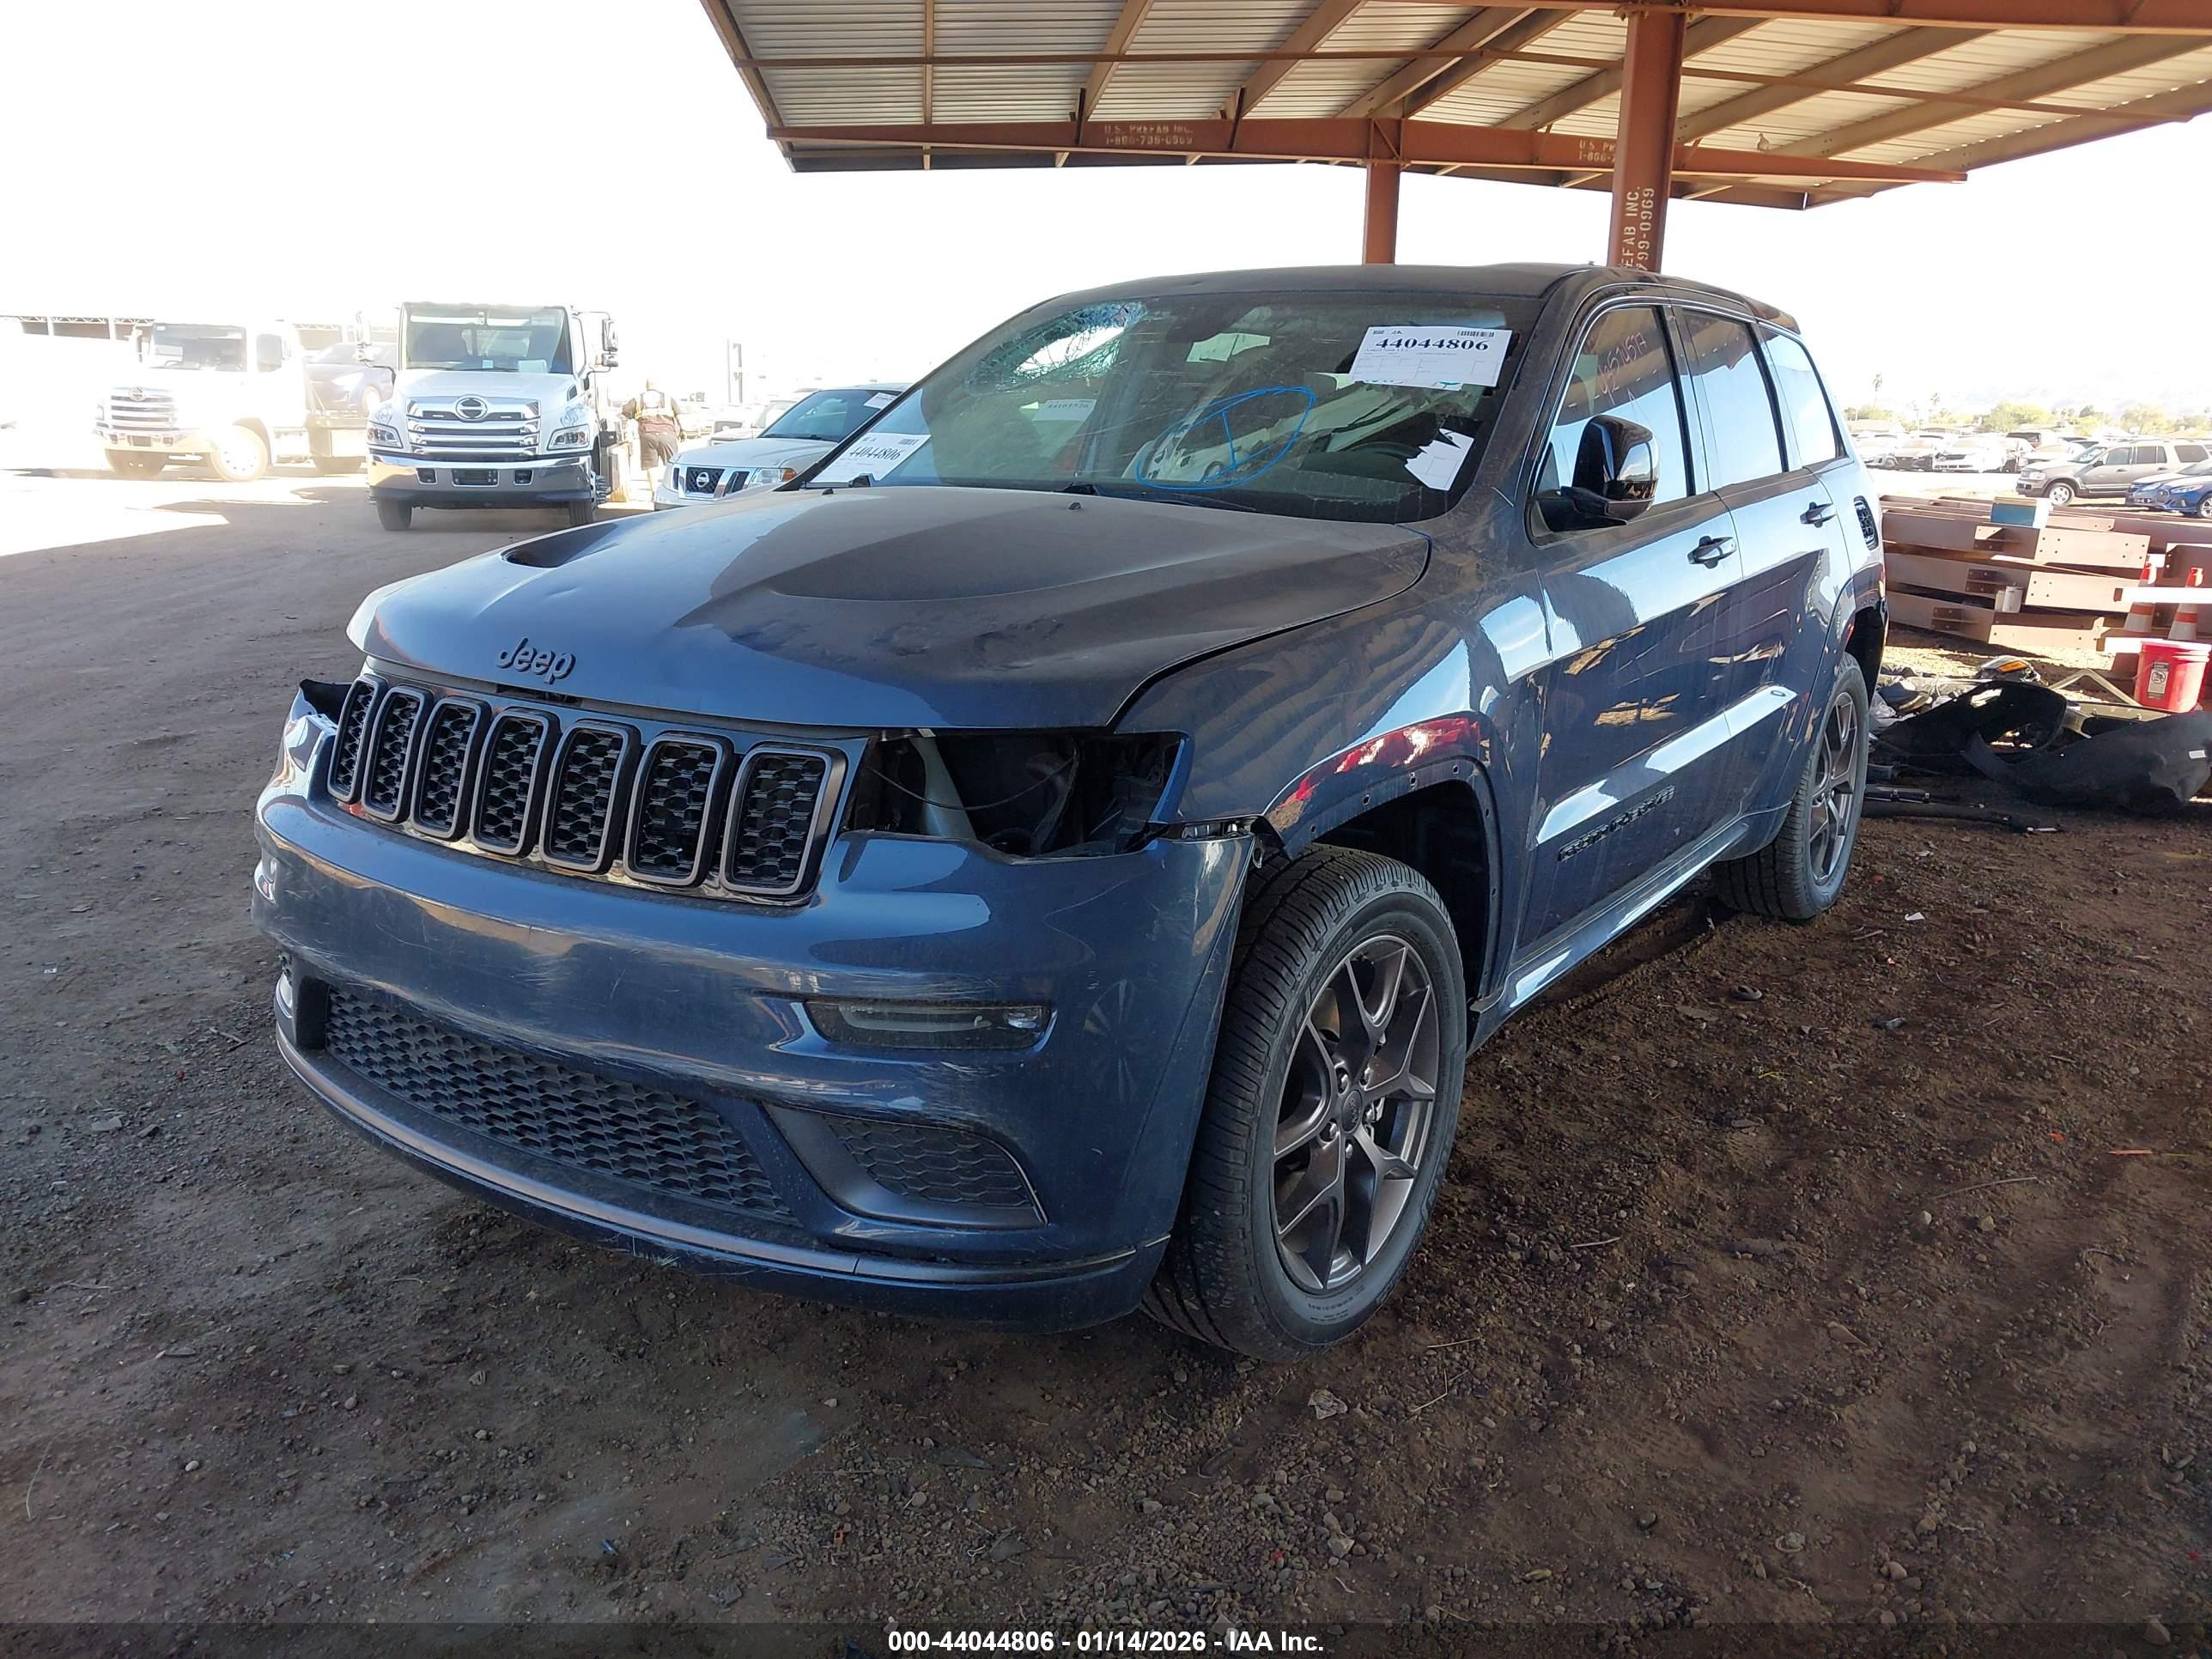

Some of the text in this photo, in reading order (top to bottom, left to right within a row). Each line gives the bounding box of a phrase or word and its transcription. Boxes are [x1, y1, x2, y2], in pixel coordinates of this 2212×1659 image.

[1625, 186, 1640, 216] INC.
[1376, 338, 1490, 350] 44044806
[849, 447, 902, 461] 44044806
[496, 637, 577, 685] Jeep
